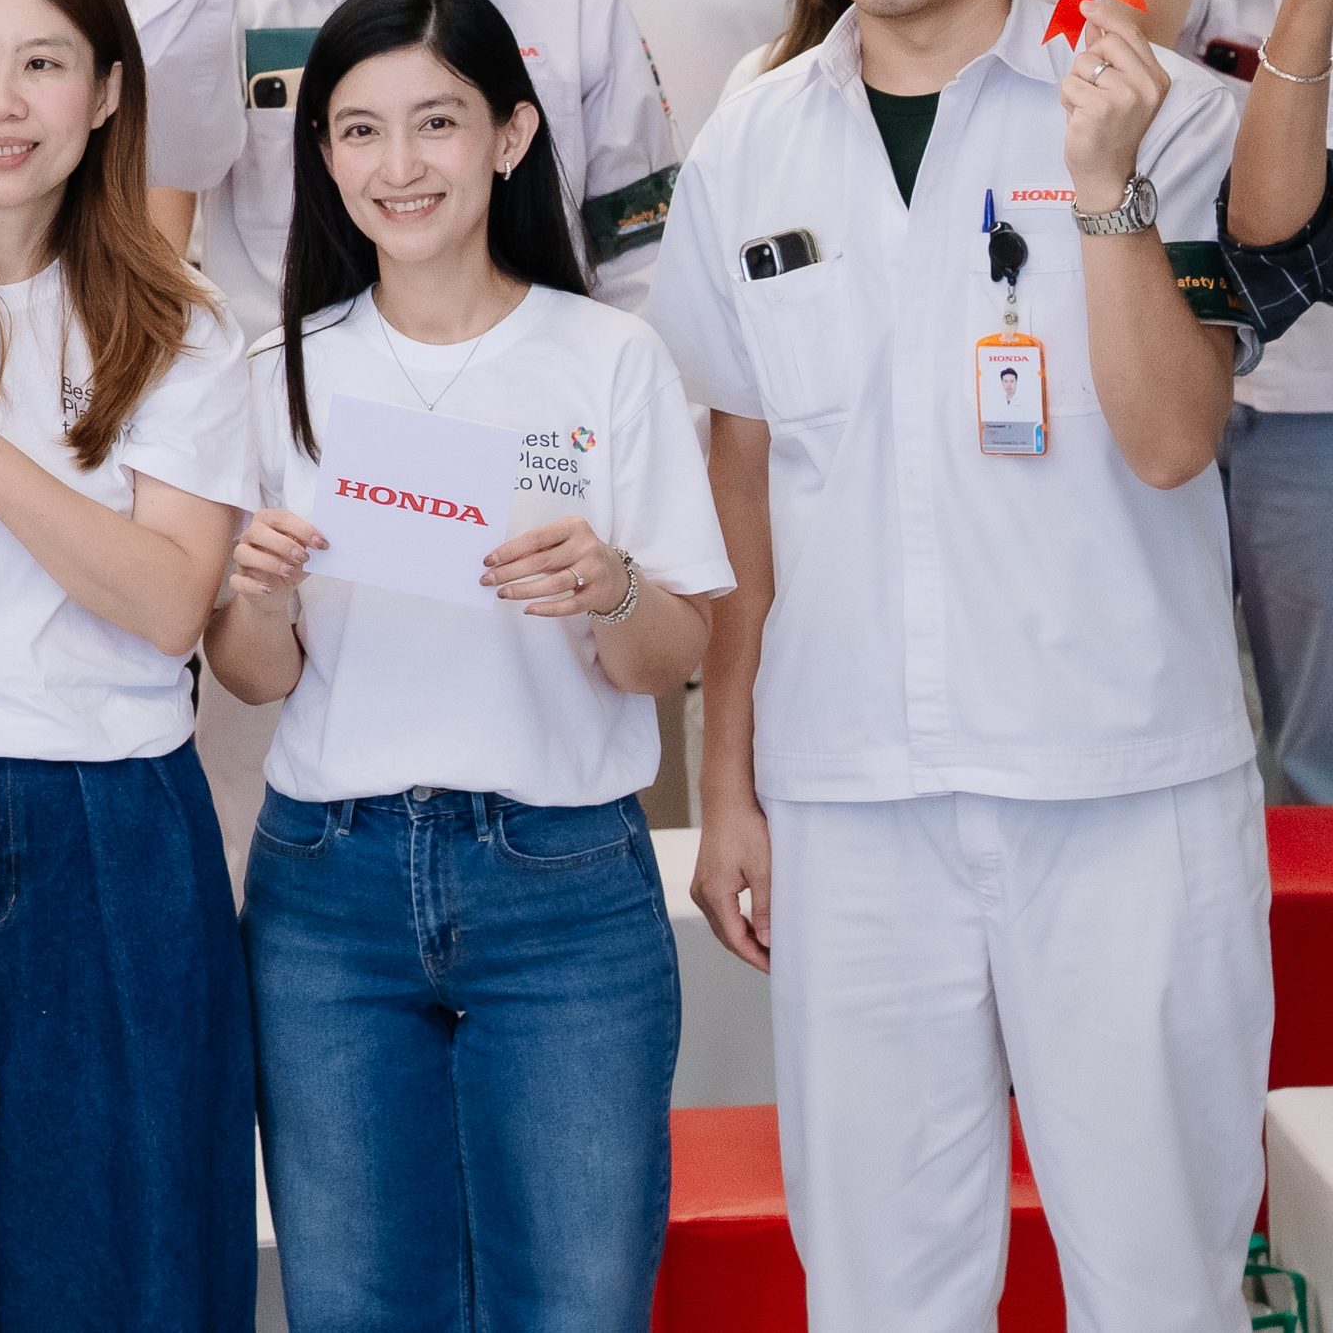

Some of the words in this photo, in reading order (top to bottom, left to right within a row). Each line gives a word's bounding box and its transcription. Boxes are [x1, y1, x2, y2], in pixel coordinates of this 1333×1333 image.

[1011, 190, 1077, 202] HOND
[1177, 275, 1215, 290] afety
[63, 375, 95, 402] Bes
[521, 430, 560, 448] est
[334, 477, 489, 527] HONDA
